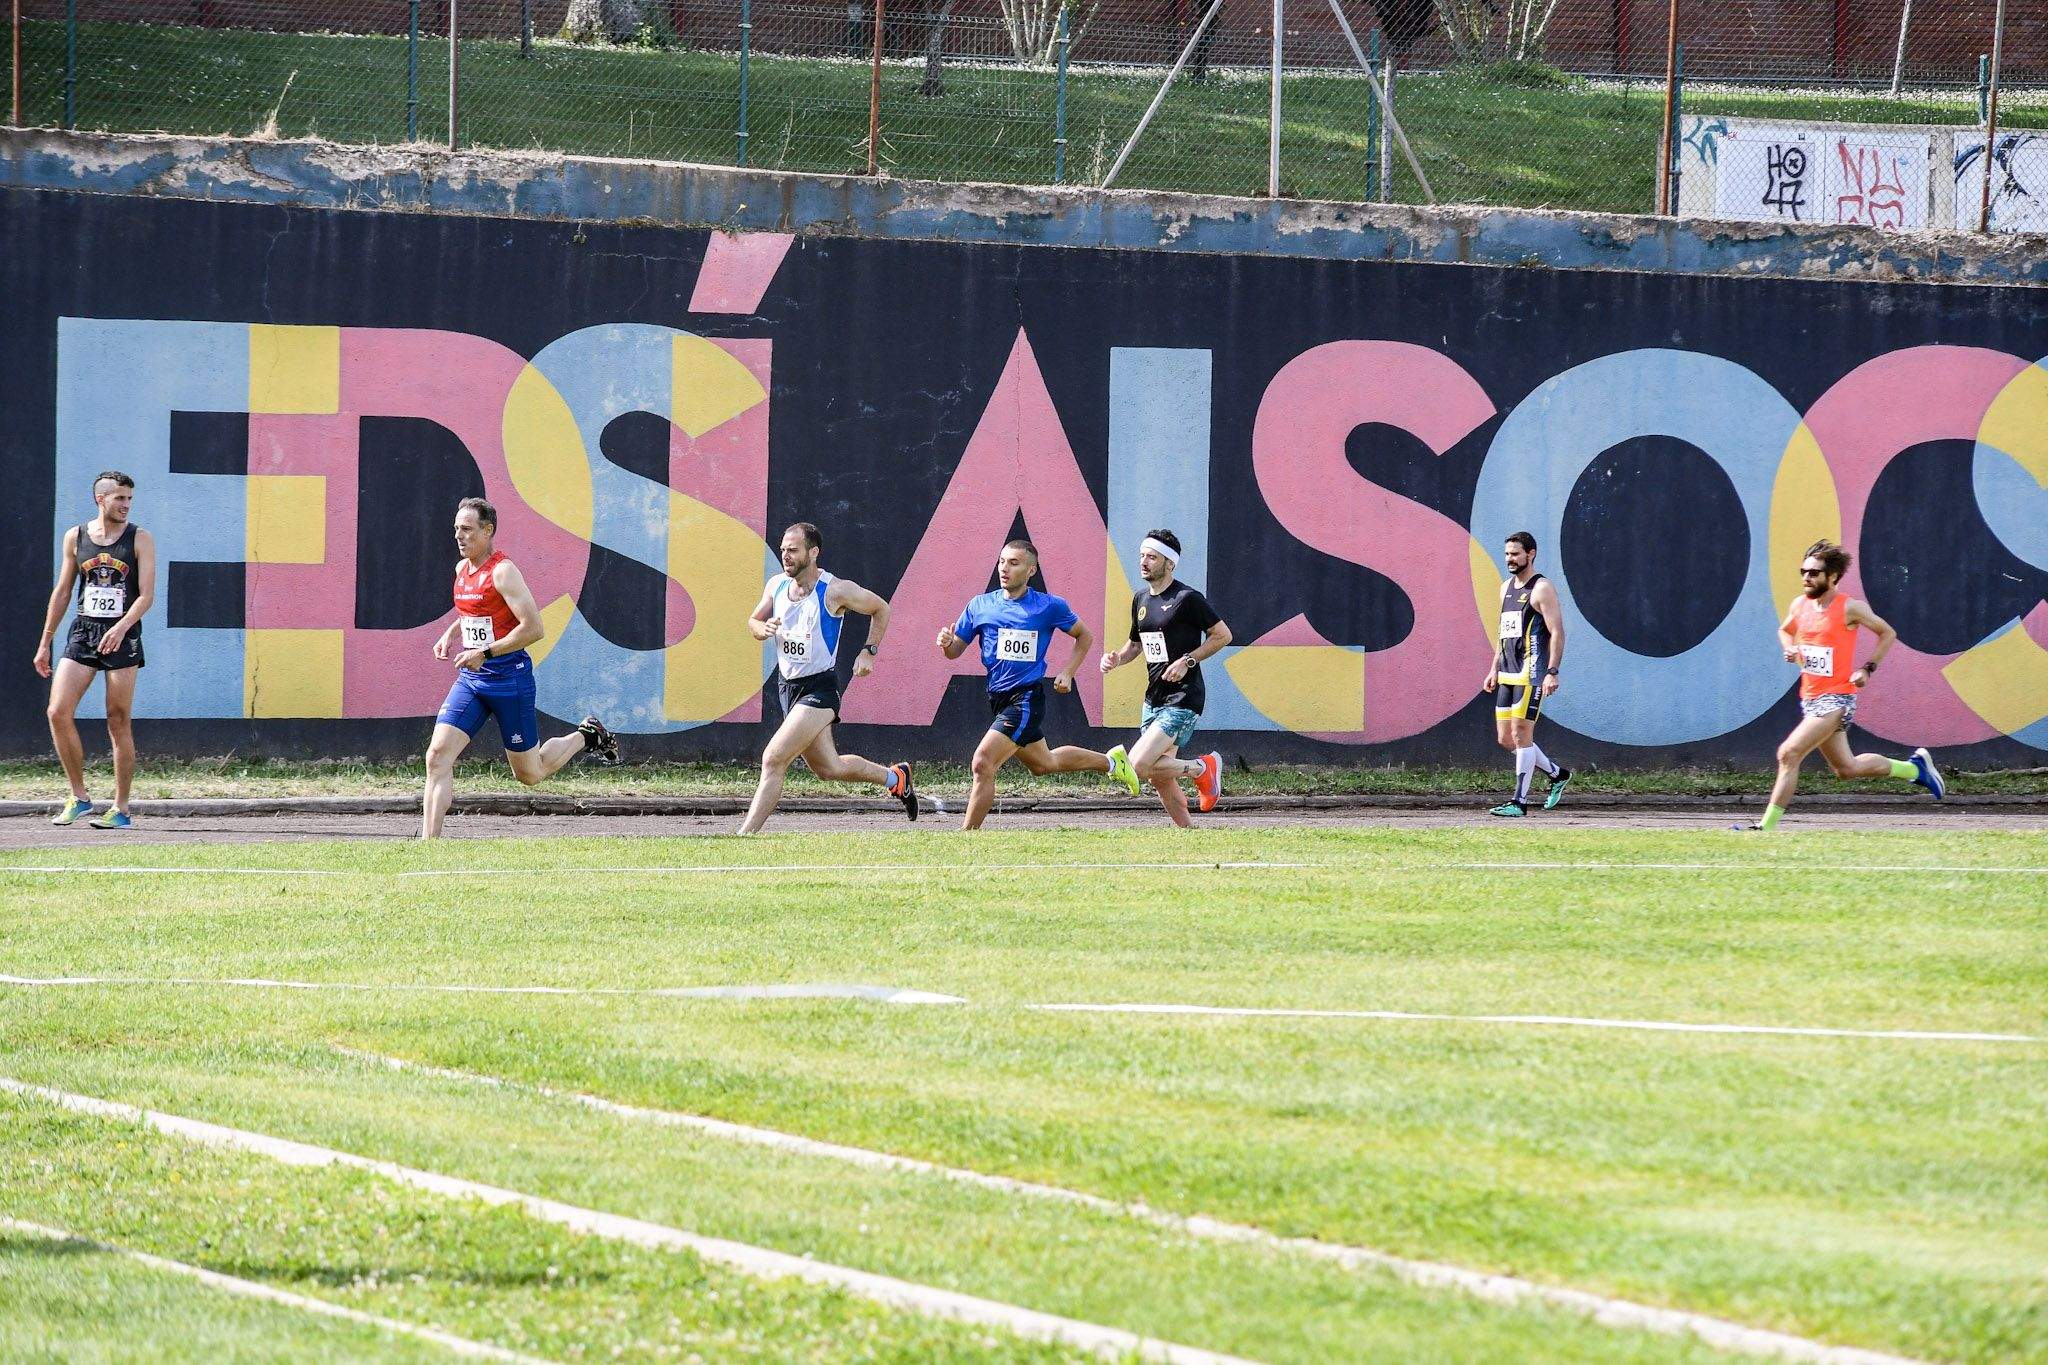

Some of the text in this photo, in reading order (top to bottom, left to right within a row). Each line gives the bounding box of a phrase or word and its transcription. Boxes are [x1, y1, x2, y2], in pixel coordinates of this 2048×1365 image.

[91, 598, 116, 611] 782
[465, 627, 487, 641] 736
[783, 641, 805, 656] 886
[1004, 639, 1030, 654] 806
[1146, 643, 1162, 656] 769
